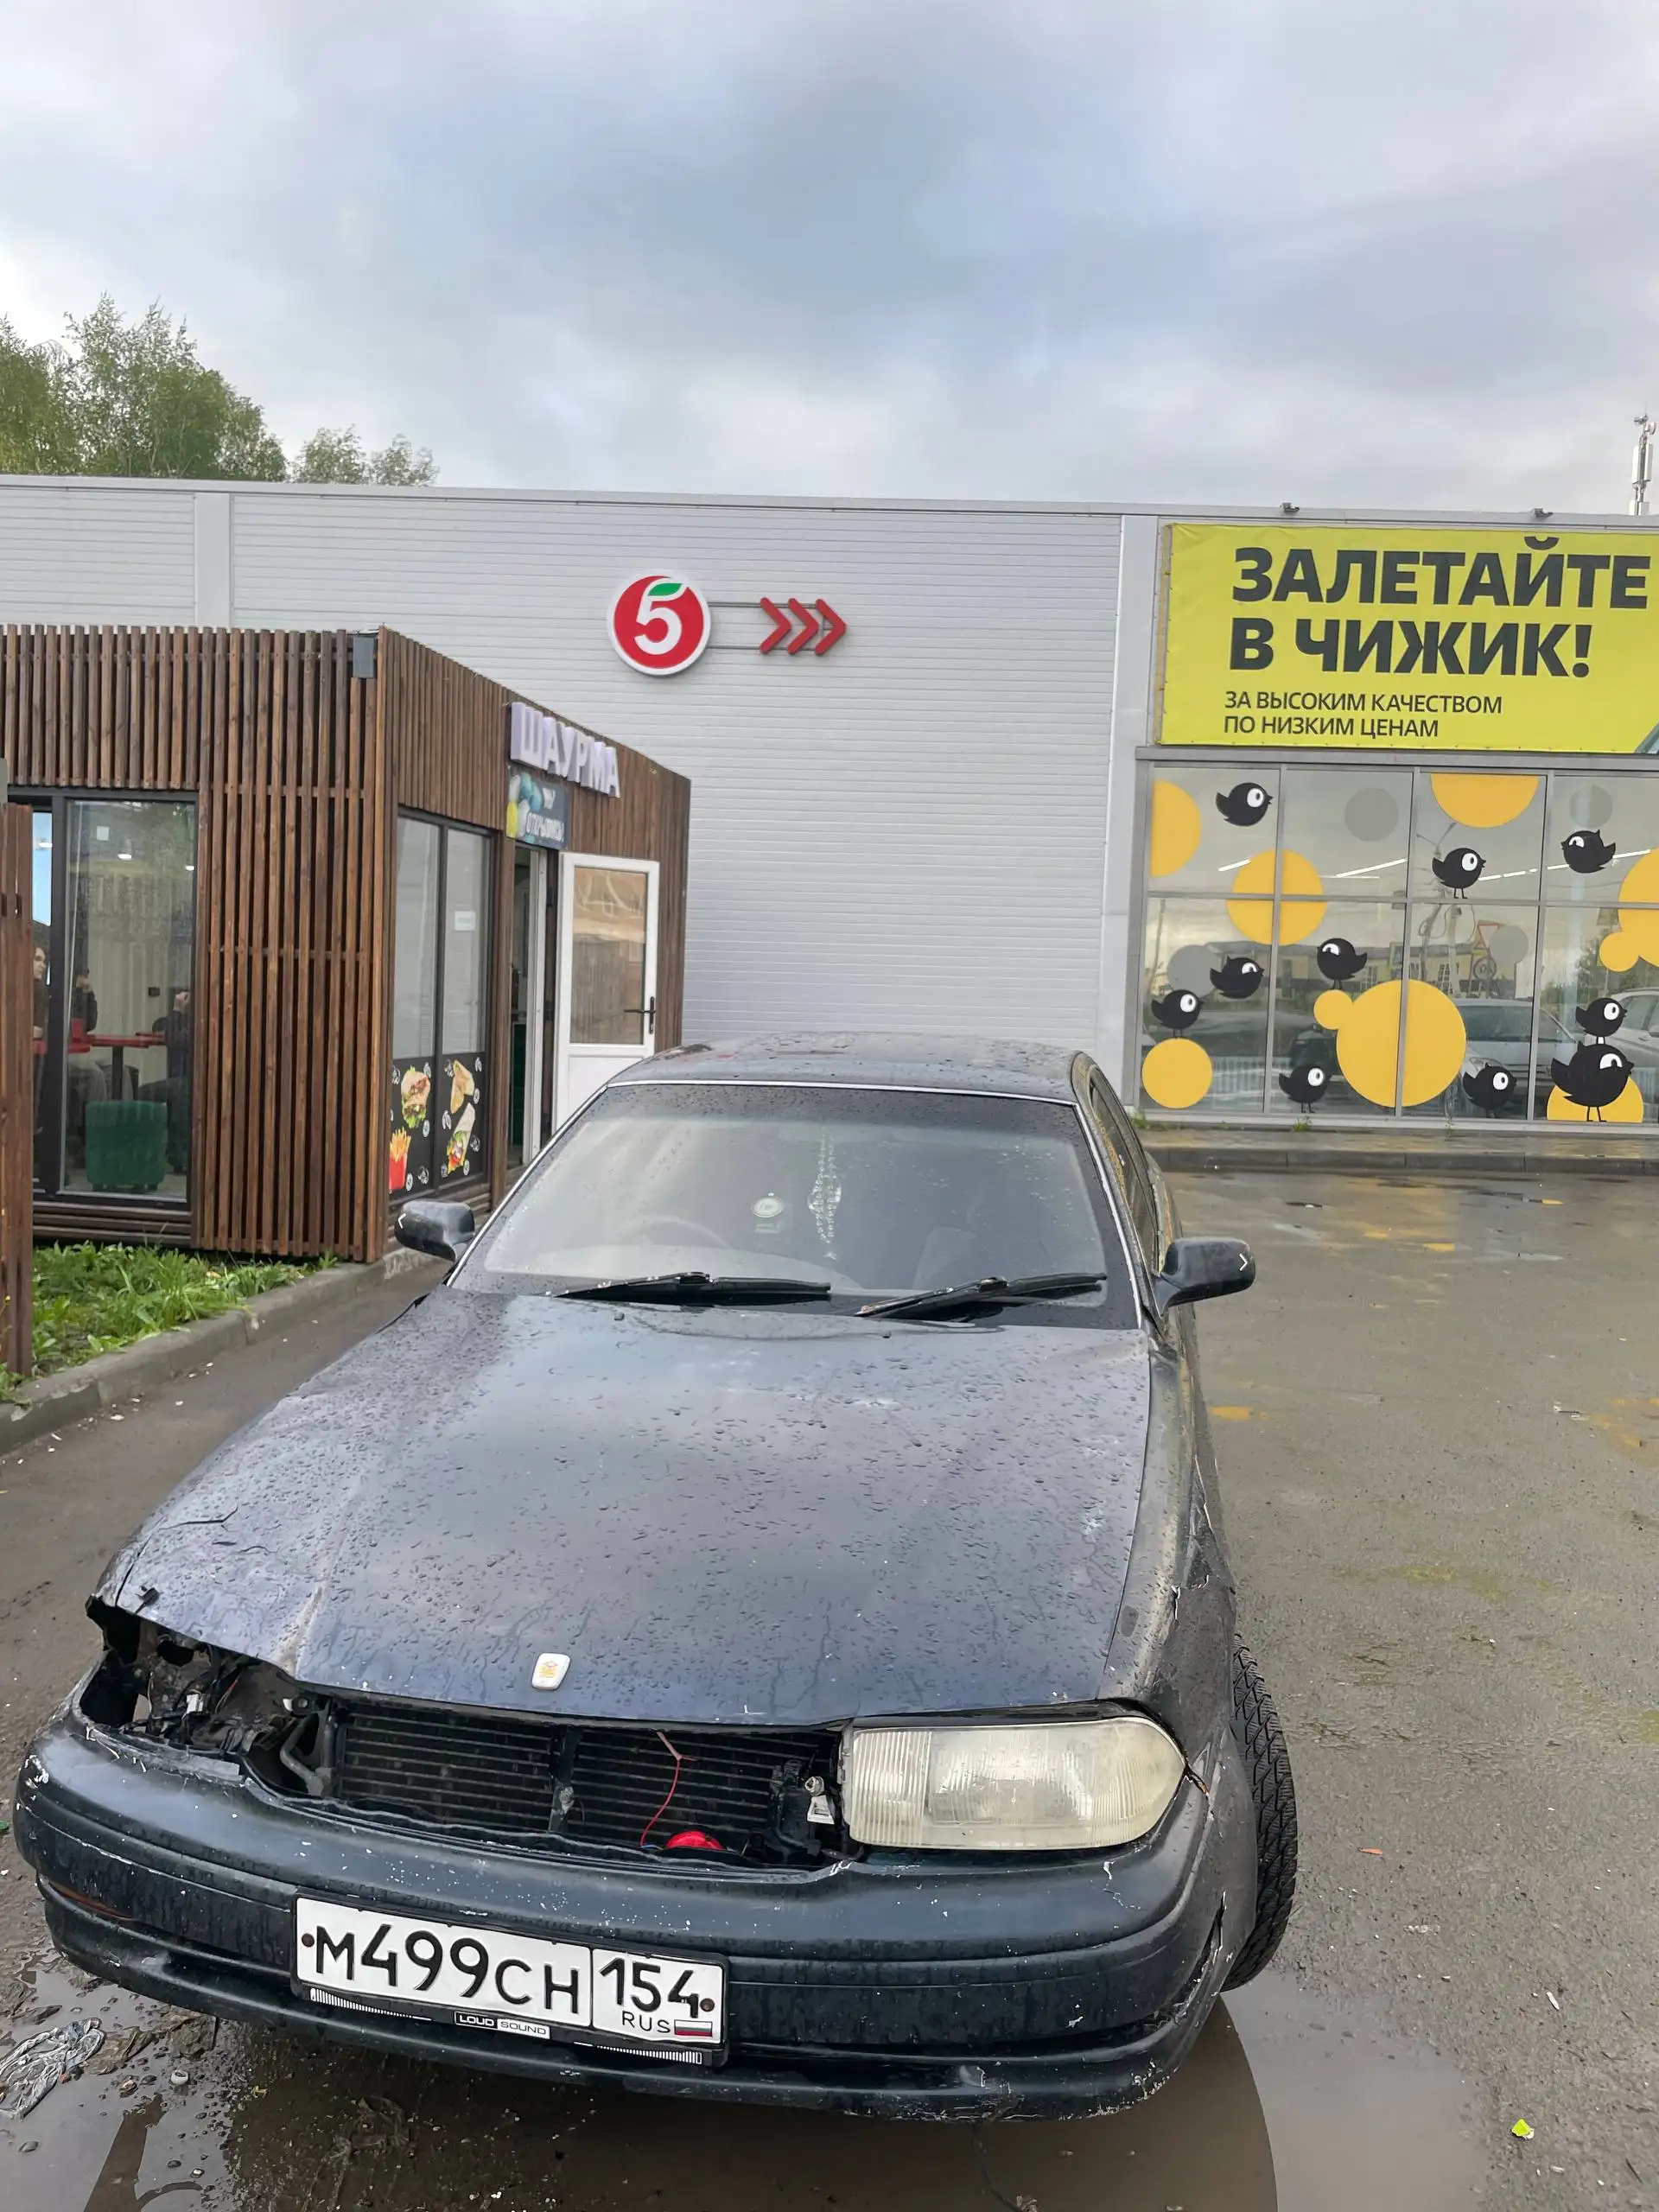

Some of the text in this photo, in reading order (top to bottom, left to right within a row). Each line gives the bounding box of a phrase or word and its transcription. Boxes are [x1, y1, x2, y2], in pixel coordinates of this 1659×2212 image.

[1232, 536, 1651, 609] ЗАЛЕТАЙТЕ
[1230, 617, 1592, 677] В ЧИЖИК!
[1224, 691, 1502, 714] ЗА ВЫСОКИМ КАЧЕСТВОМ
[1224, 716, 1439, 740] ПО НИЗКИМ ЦЕНАМ
[510, 702, 620, 798] ШАУРМА
[315, 1923, 700, 2018] М499СН 154
[459, 2014, 547, 2035] LOUD SOUND
[621, 2011, 671, 2034] RUS
